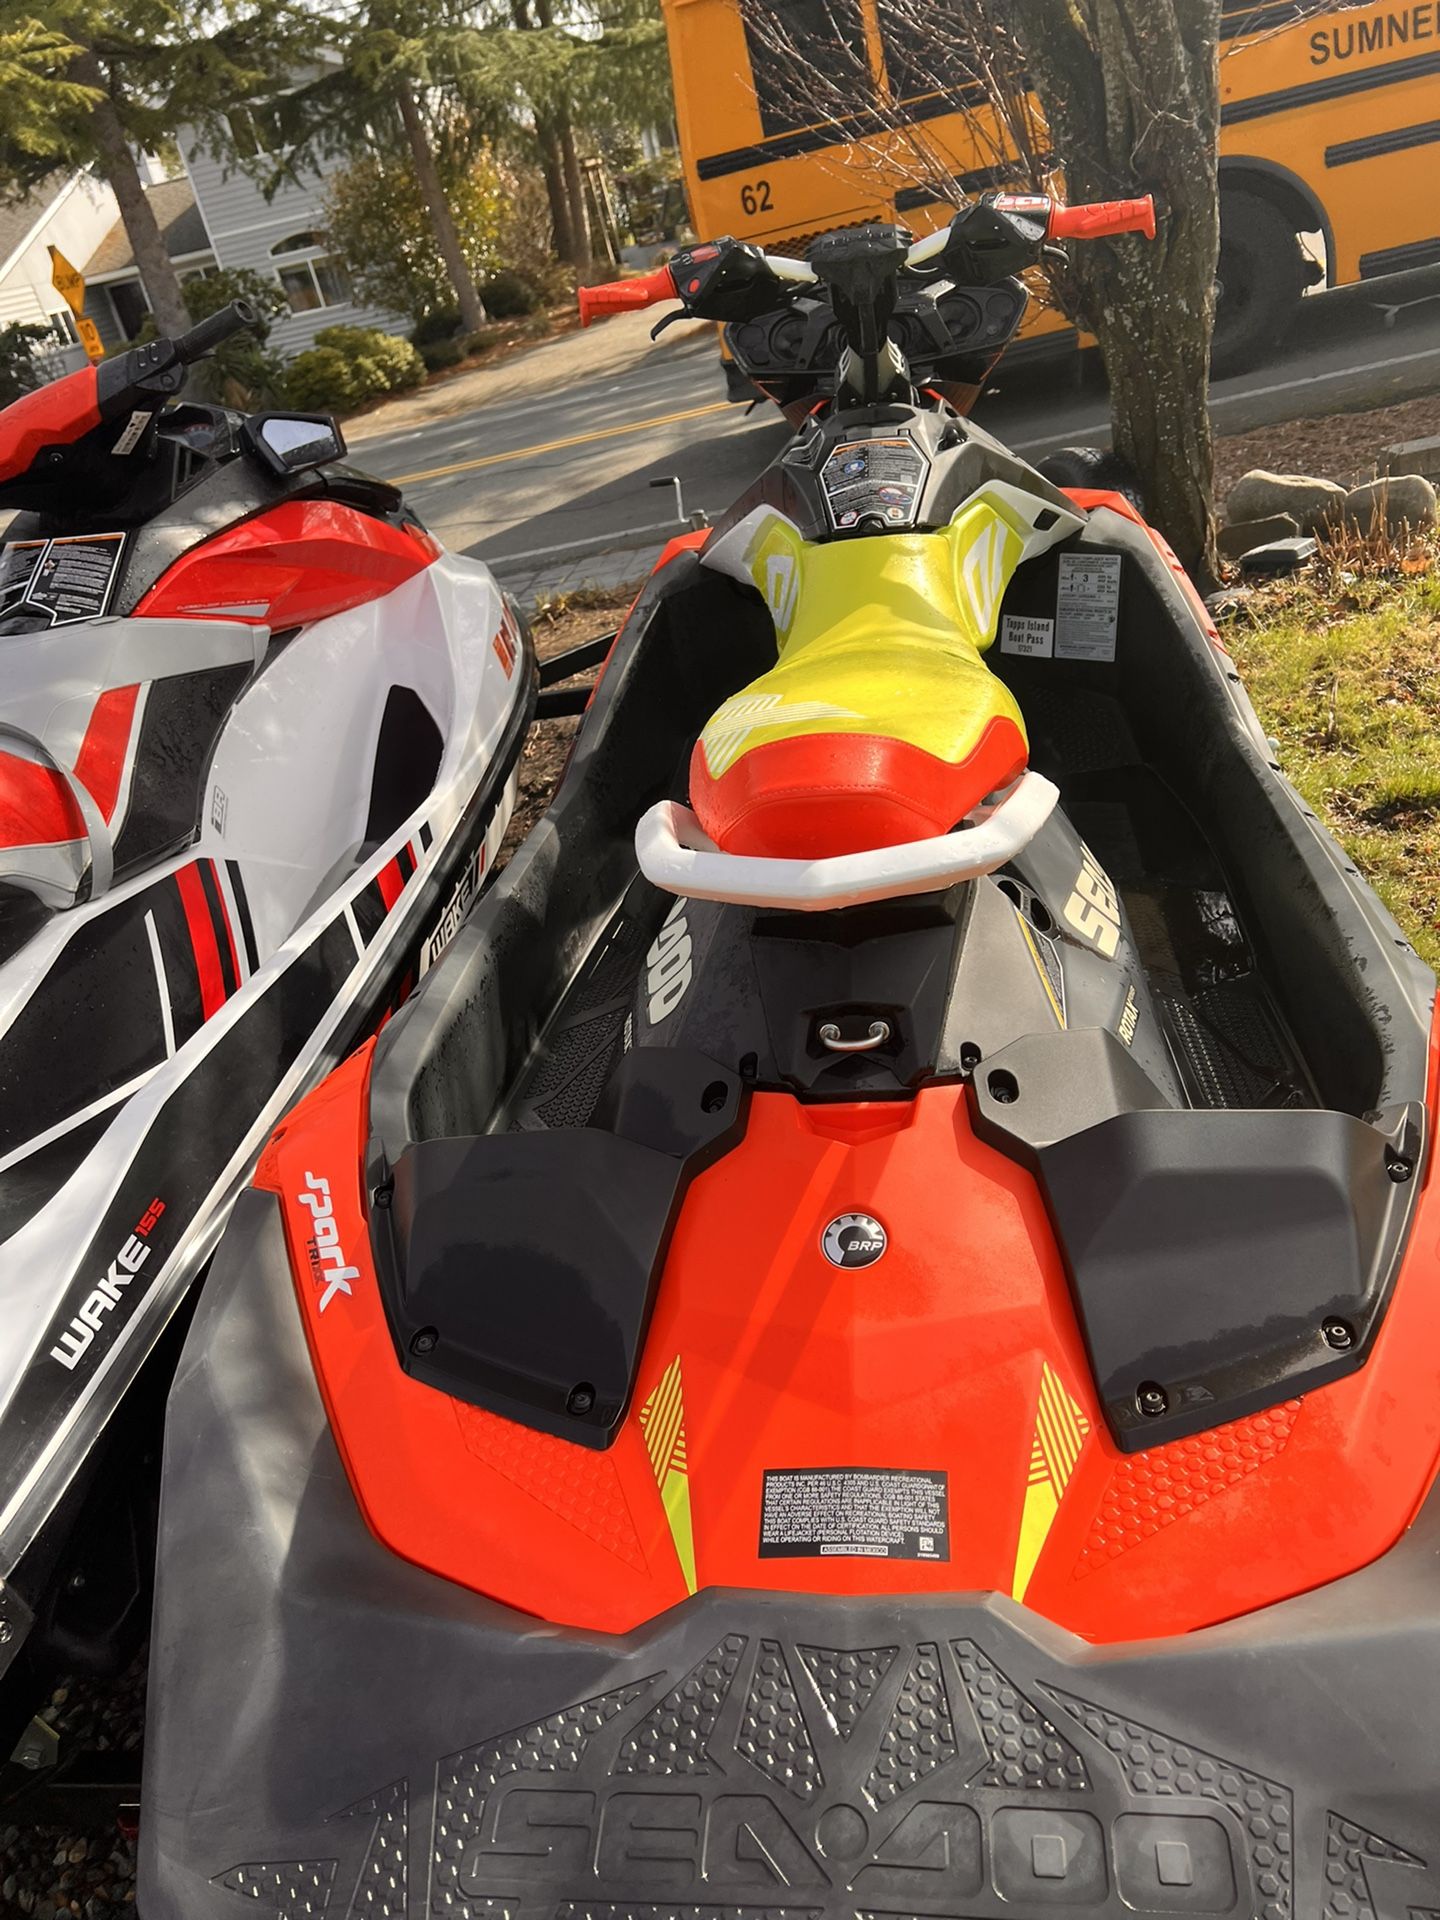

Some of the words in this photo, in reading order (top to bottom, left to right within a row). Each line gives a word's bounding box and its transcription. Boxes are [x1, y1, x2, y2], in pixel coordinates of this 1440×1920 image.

[1310, 1, 1440, 65] SUMNE
[741, 180, 774, 216] 62
[1082, 573, 1089, 583] 3
[1006, 617, 1025, 631] Tapps
[1027, 620, 1050, 632] Island
[1008, 631, 1025, 643] Boat
[1026, 633, 1044, 645] Pass
[1118, 997, 1140, 1047] ROTAX
[847, 1240, 883, 1252] BRP
[50, 1233, 151, 1371] WAKE
[134, 1197, 167, 1238] 155
